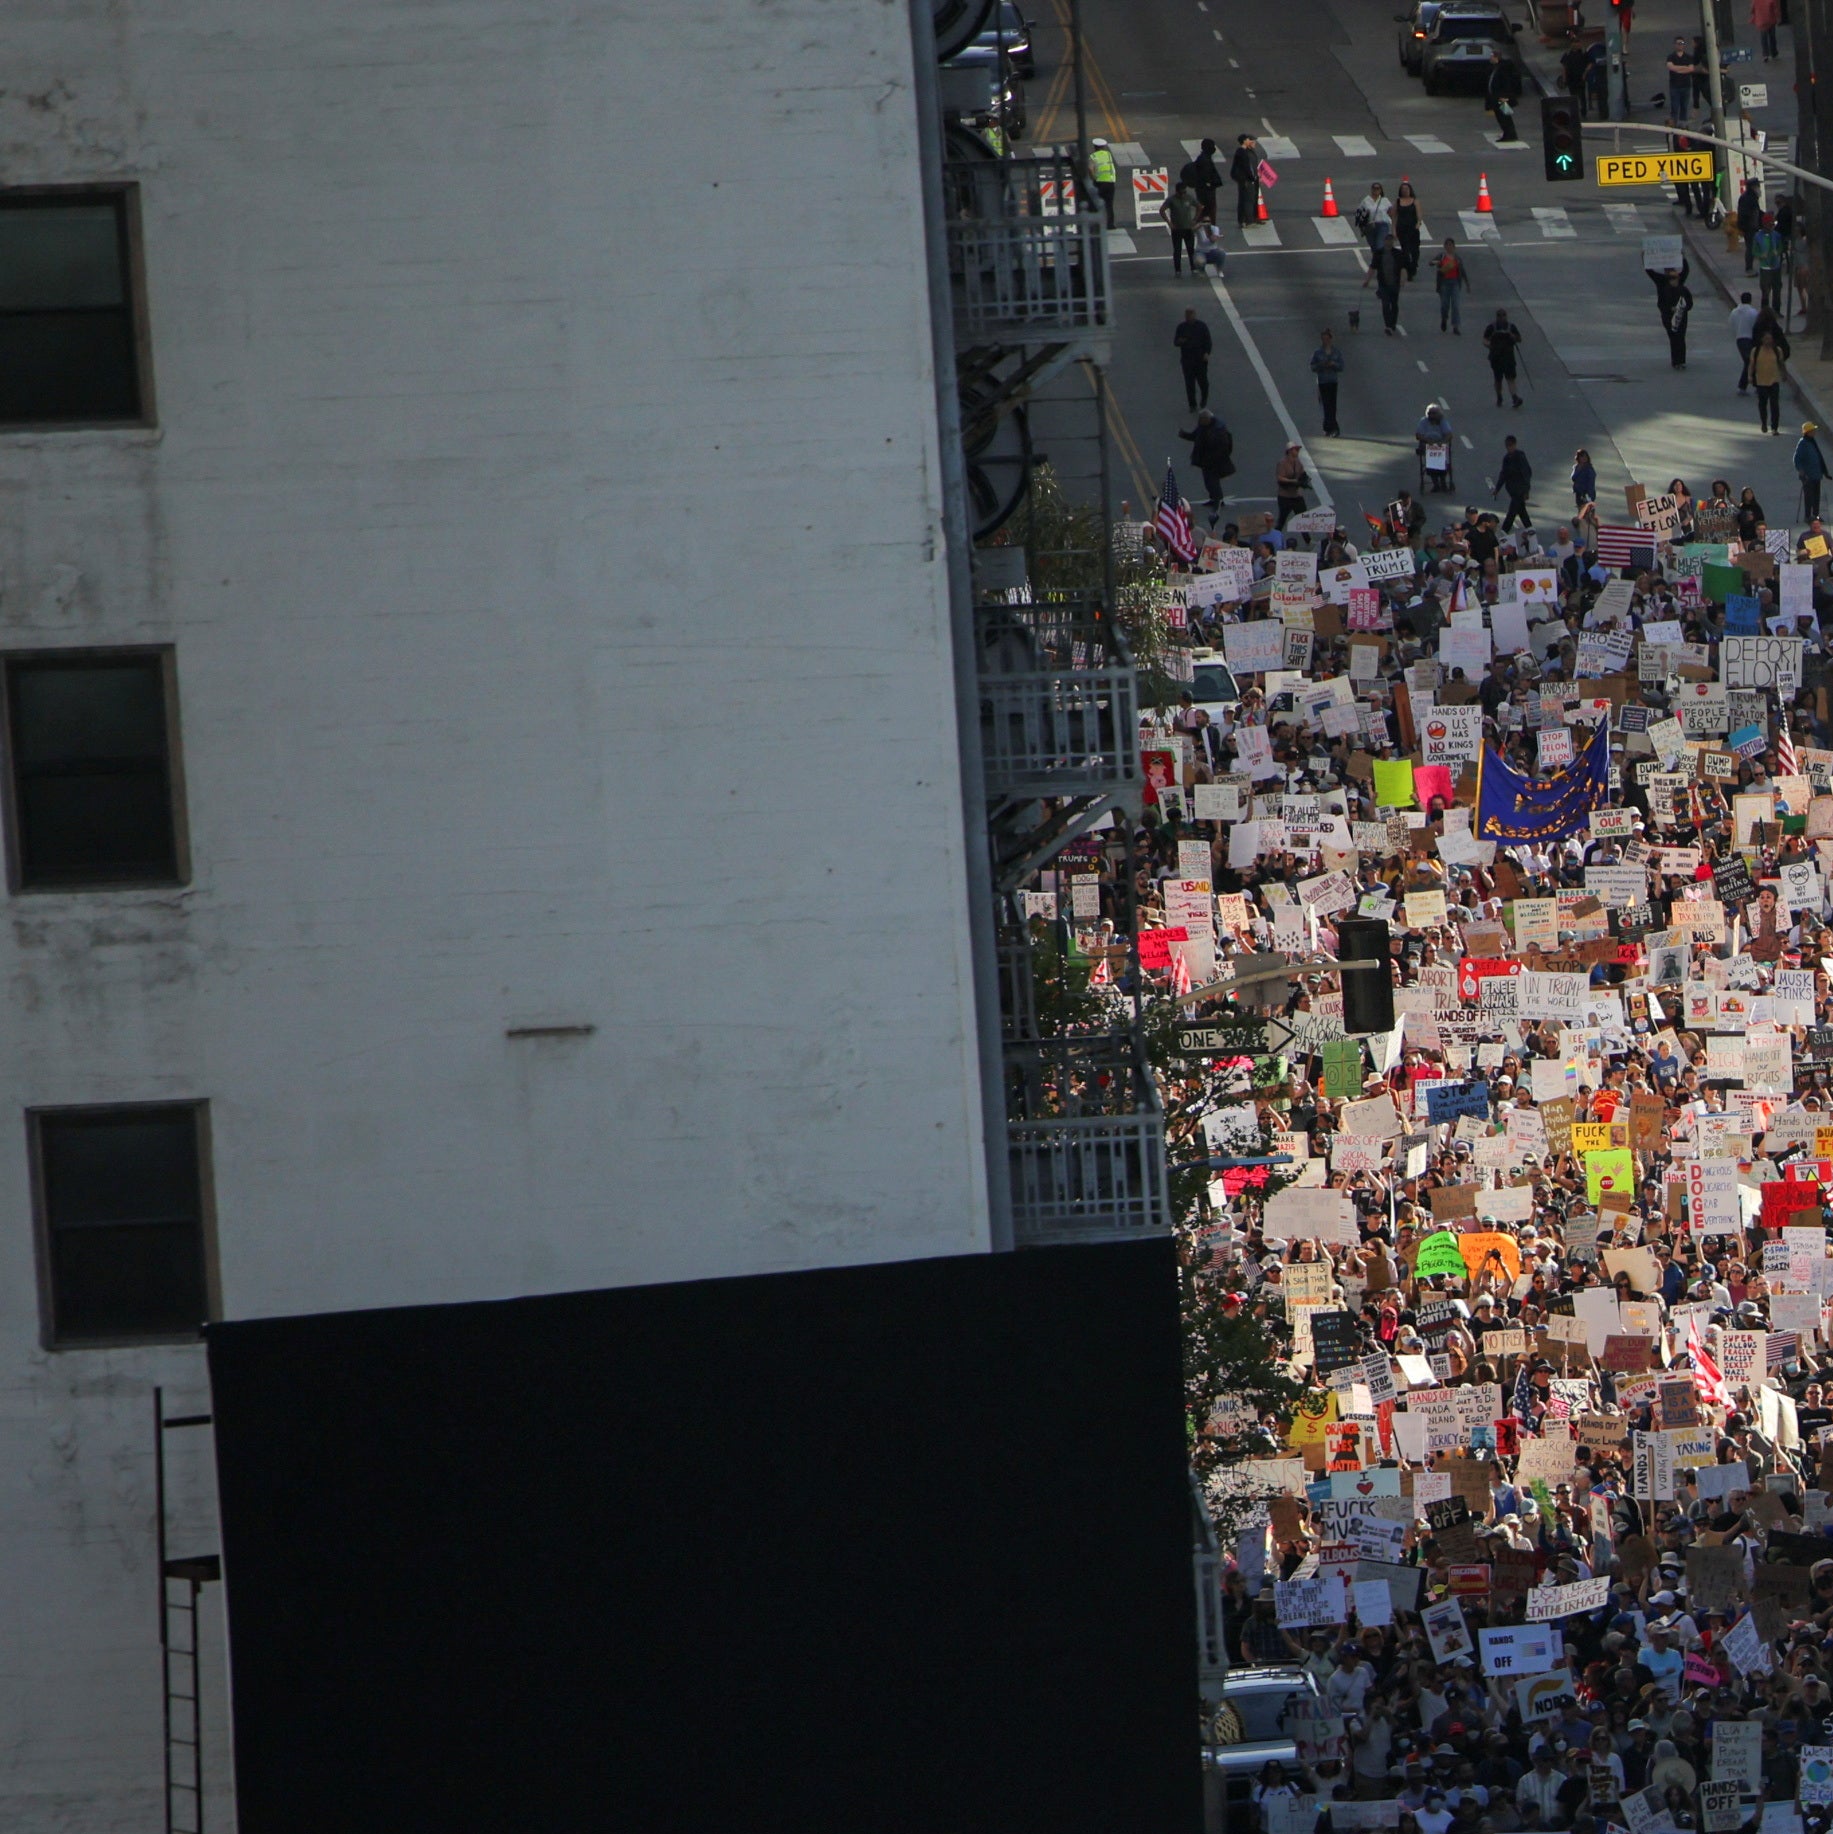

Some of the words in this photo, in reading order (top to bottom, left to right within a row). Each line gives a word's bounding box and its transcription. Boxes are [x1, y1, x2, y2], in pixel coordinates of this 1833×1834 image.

[1608, 162, 1648, 179] PED
[1657, 159, 1703, 178] XING
[1361, 551, 1404, 566] DUMP
[1366, 560, 1409, 577] TRUMP
[1291, 633, 1308, 643] FUCK
[1290, 644, 1307, 655] THIS
[1726, 638, 1801, 663] DEPORT
[1707, 755, 1730, 767] DUMP
[1600, 816, 1622, 828] OUR
[1779, 972, 1812, 986] MUSK
[1481, 980, 1516, 994] FREE
[1775, 986, 1812, 1000] STINKS
[1181, 1030, 1216, 1048] ONE
[1575, 1125, 1606, 1138] FUCK
[1676, 1442, 1710, 1456] TAXING
[1489, 1635, 1514, 1645] HANDS
[1494, 1656, 1512, 1668] OFF
[1702, 1780, 1737, 1796] HANDS
[1706, 1794, 1735, 1810] OFF
